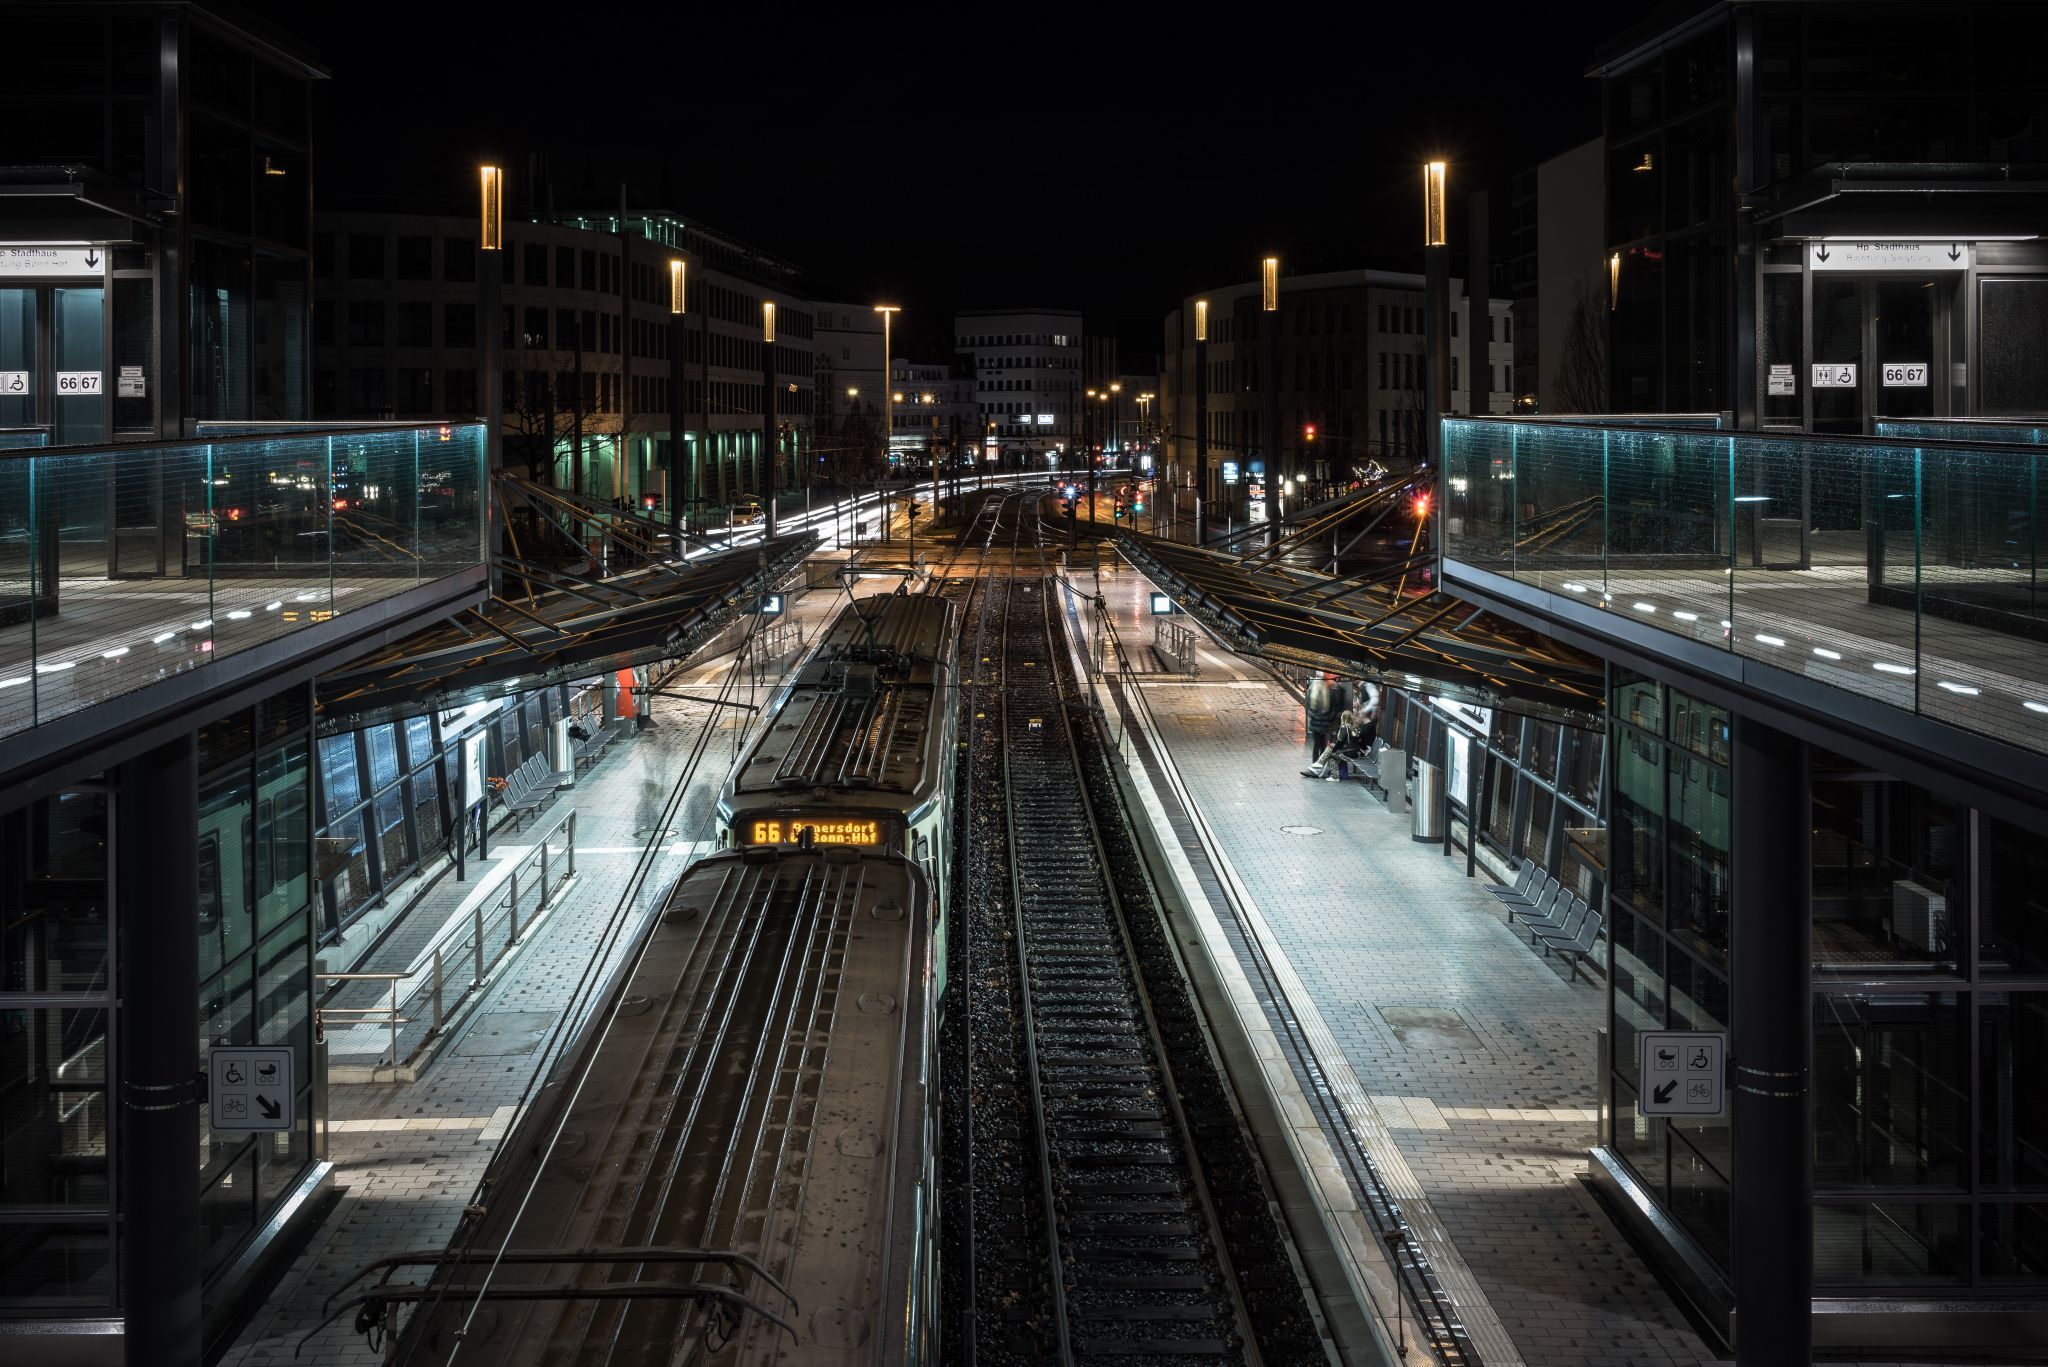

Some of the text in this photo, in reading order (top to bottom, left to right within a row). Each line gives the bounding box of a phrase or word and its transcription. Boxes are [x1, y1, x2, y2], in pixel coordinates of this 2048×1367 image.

[11, 248, 58, 257] Stadthaus
[1874, 243, 1920, 251] Stadthaus
[1886, 369, 1924, 381] 66 67
[60, 377, 98, 389] 66 67
[755, 823, 780, 843] 66
[792, 822, 876, 833] Rmersdorf
